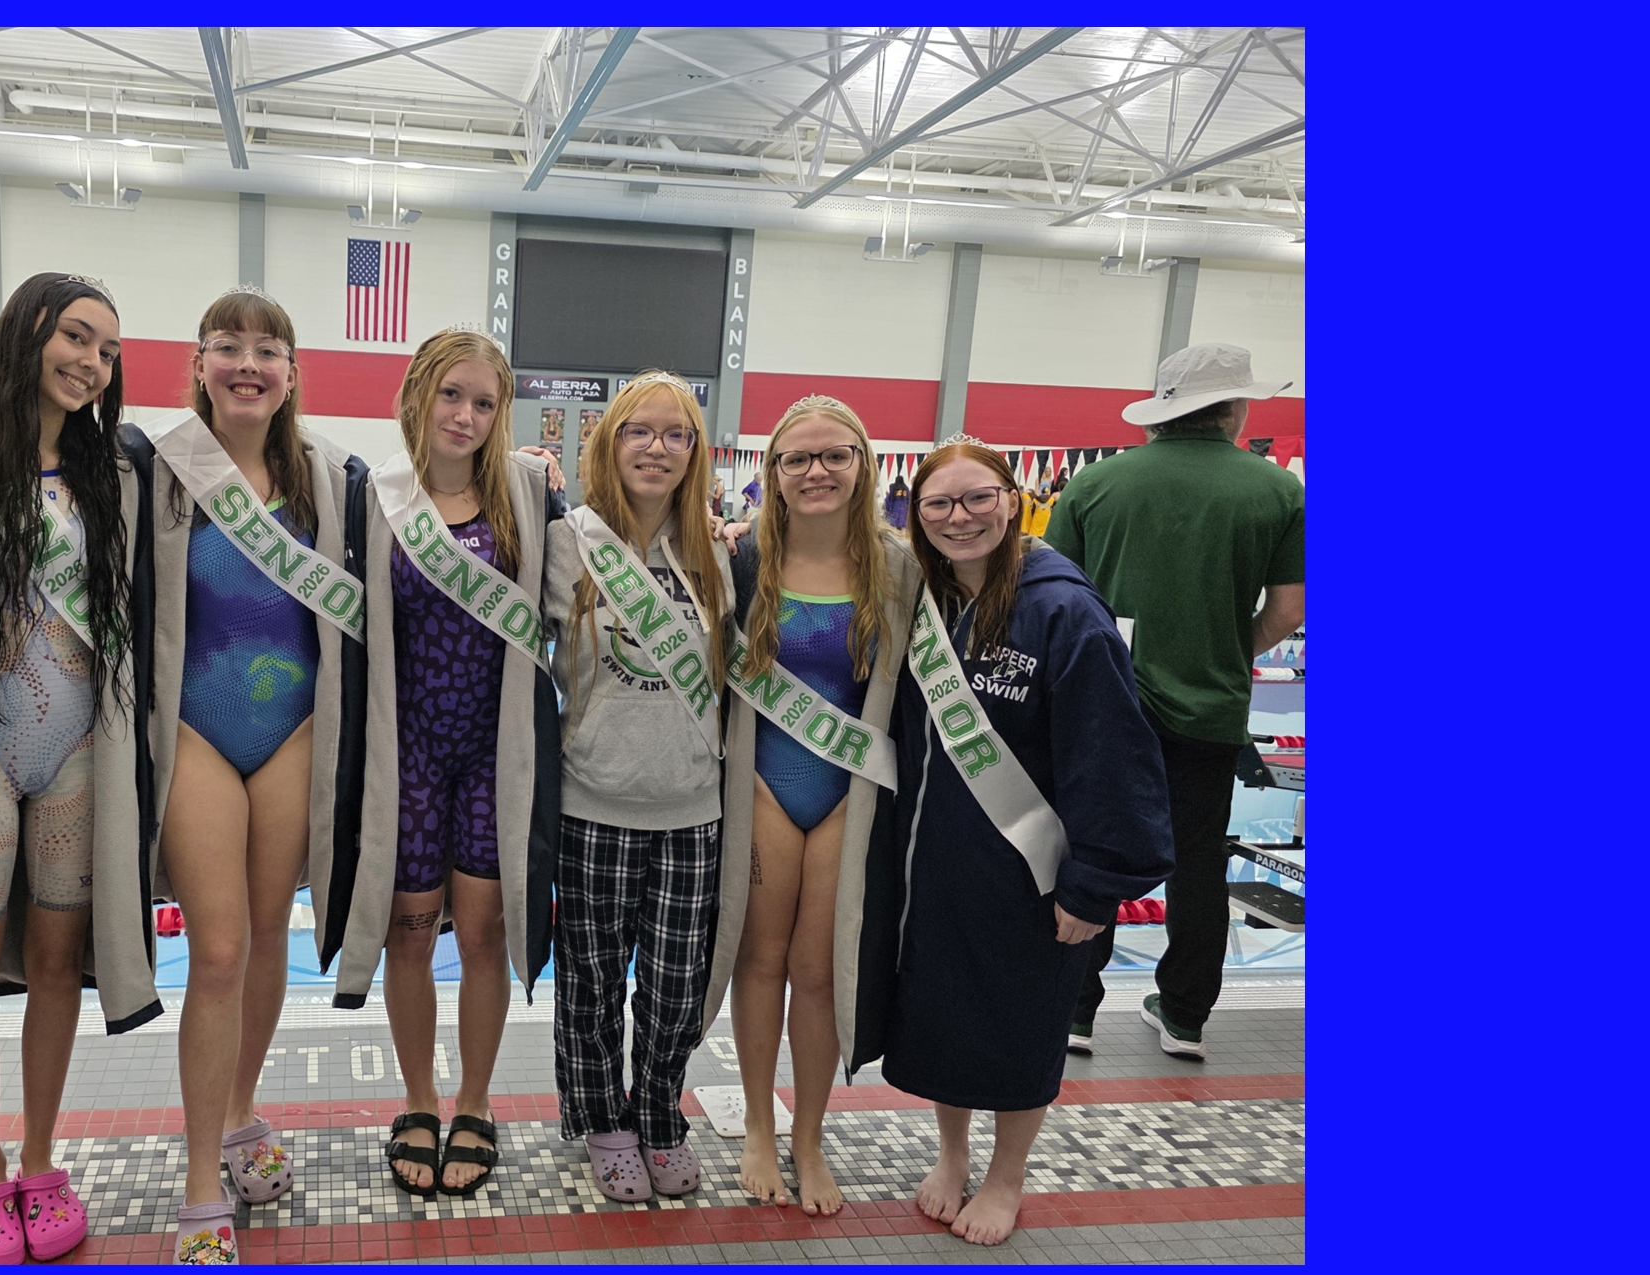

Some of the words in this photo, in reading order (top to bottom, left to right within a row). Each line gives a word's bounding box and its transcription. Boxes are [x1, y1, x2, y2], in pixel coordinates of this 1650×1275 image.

[726, 257, 747, 369] BLANC
[529, 379, 549, 389] AL
[552, 380, 601, 391] SERRA
[297, 563, 330, 599] 2026
[477, 583, 509, 620] 2026
[651, 628, 688, 662] 2026
[601, 655, 636, 686] SWIM
[971, 673, 1029, 702] SWIM
[927, 674, 960, 704] 2026
[780, 692, 813, 728] 2026
